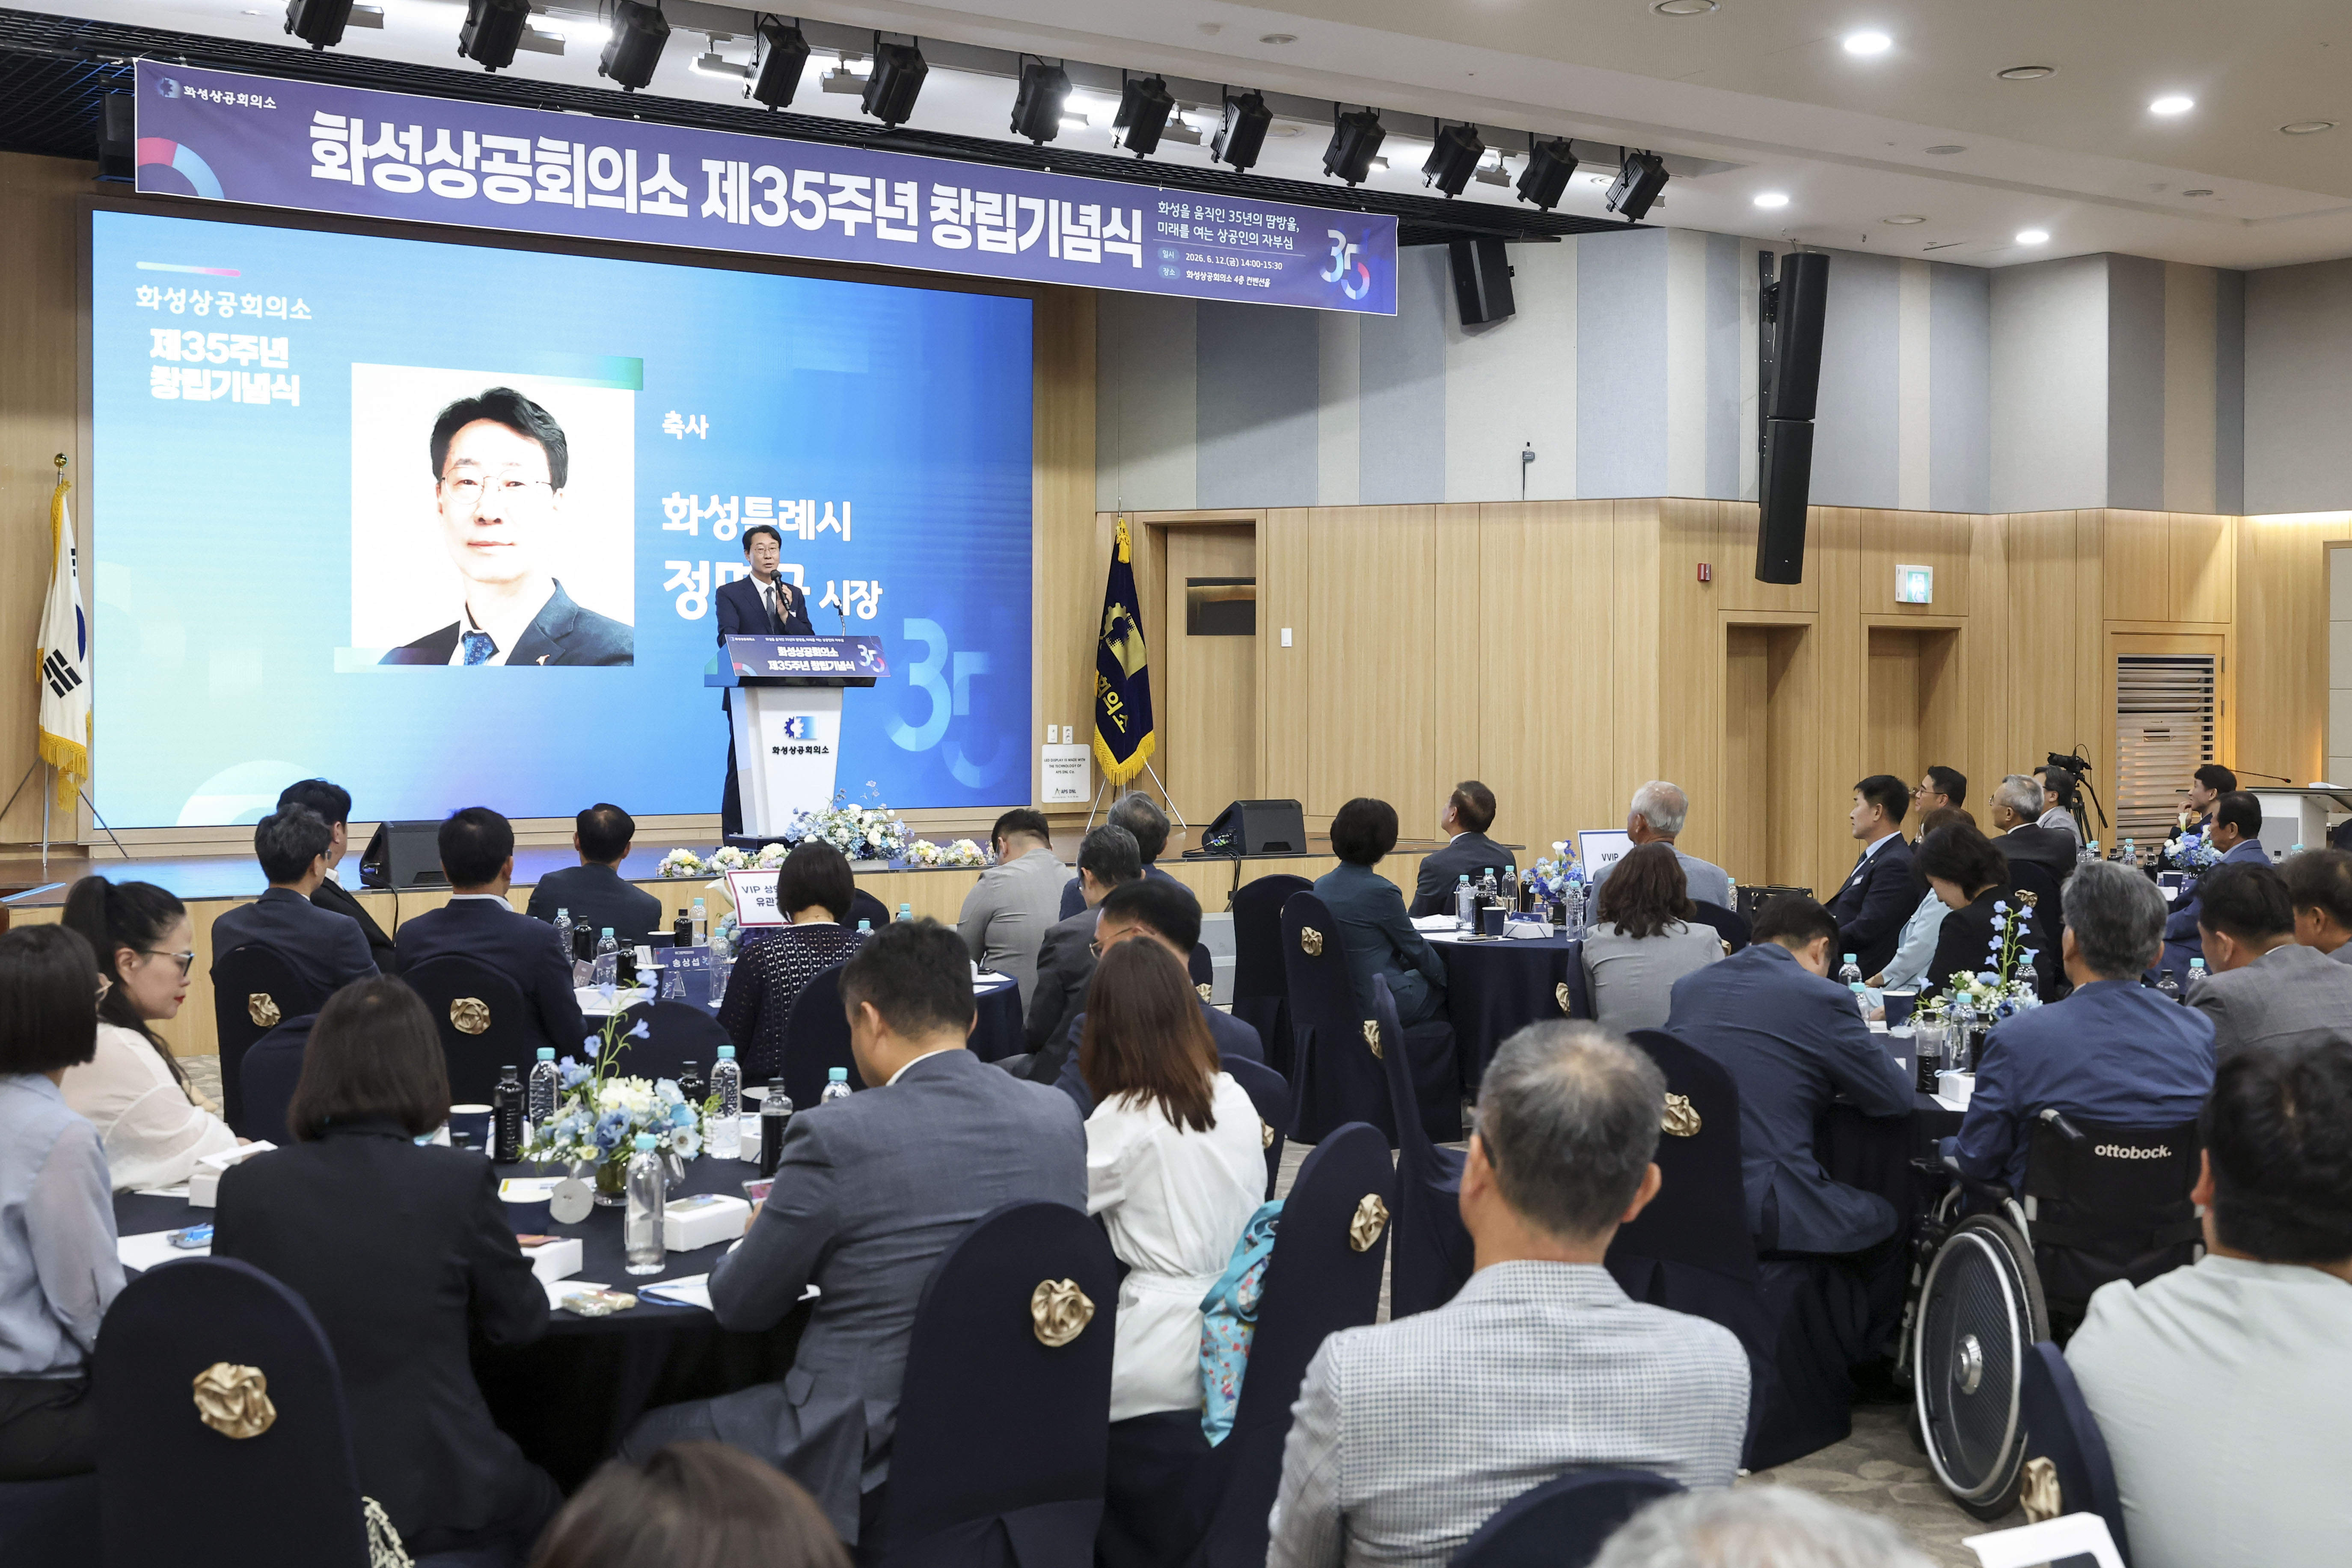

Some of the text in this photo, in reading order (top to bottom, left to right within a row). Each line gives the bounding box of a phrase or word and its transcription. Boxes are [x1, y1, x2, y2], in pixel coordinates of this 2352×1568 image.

[183, 86, 276, 109] 화성상공회의소
[310, 110, 1142, 268] 화성상공회의소 제35주년 창립기념식
[1158, 201, 1299, 233] 화성을 움직인 35년의 땀방울,
[1158, 222, 1293, 250] 미래를 여는 상공인의 자부심
[1162, 250, 1174, 259] 일시
[1185, 253, 1205, 263] 2026.
[1241, 258, 1283, 270] 14:00-15:30
[1163, 267, 1176, 276] 장소
[1186, 270, 1271, 288] 화성상공회의소 4층 컨벤션홀
[136, 285, 312, 320] 화성상공회의소
[150, 328, 288, 368] 제35주년
[150, 365, 300, 407] 창립기념식
[662, 410, 709, 440] 축사
[662, 491, 851, 541] 화성특례시
[819, 579, 883, 620] 시장
[777, 646, 839, 657] 화성상공회의소
[767, 660, 856, 671] 제35주년 창립기념식
[772, 745, 829, 754] 화성상공회의소
[756, 897, 778, 906] 유관
